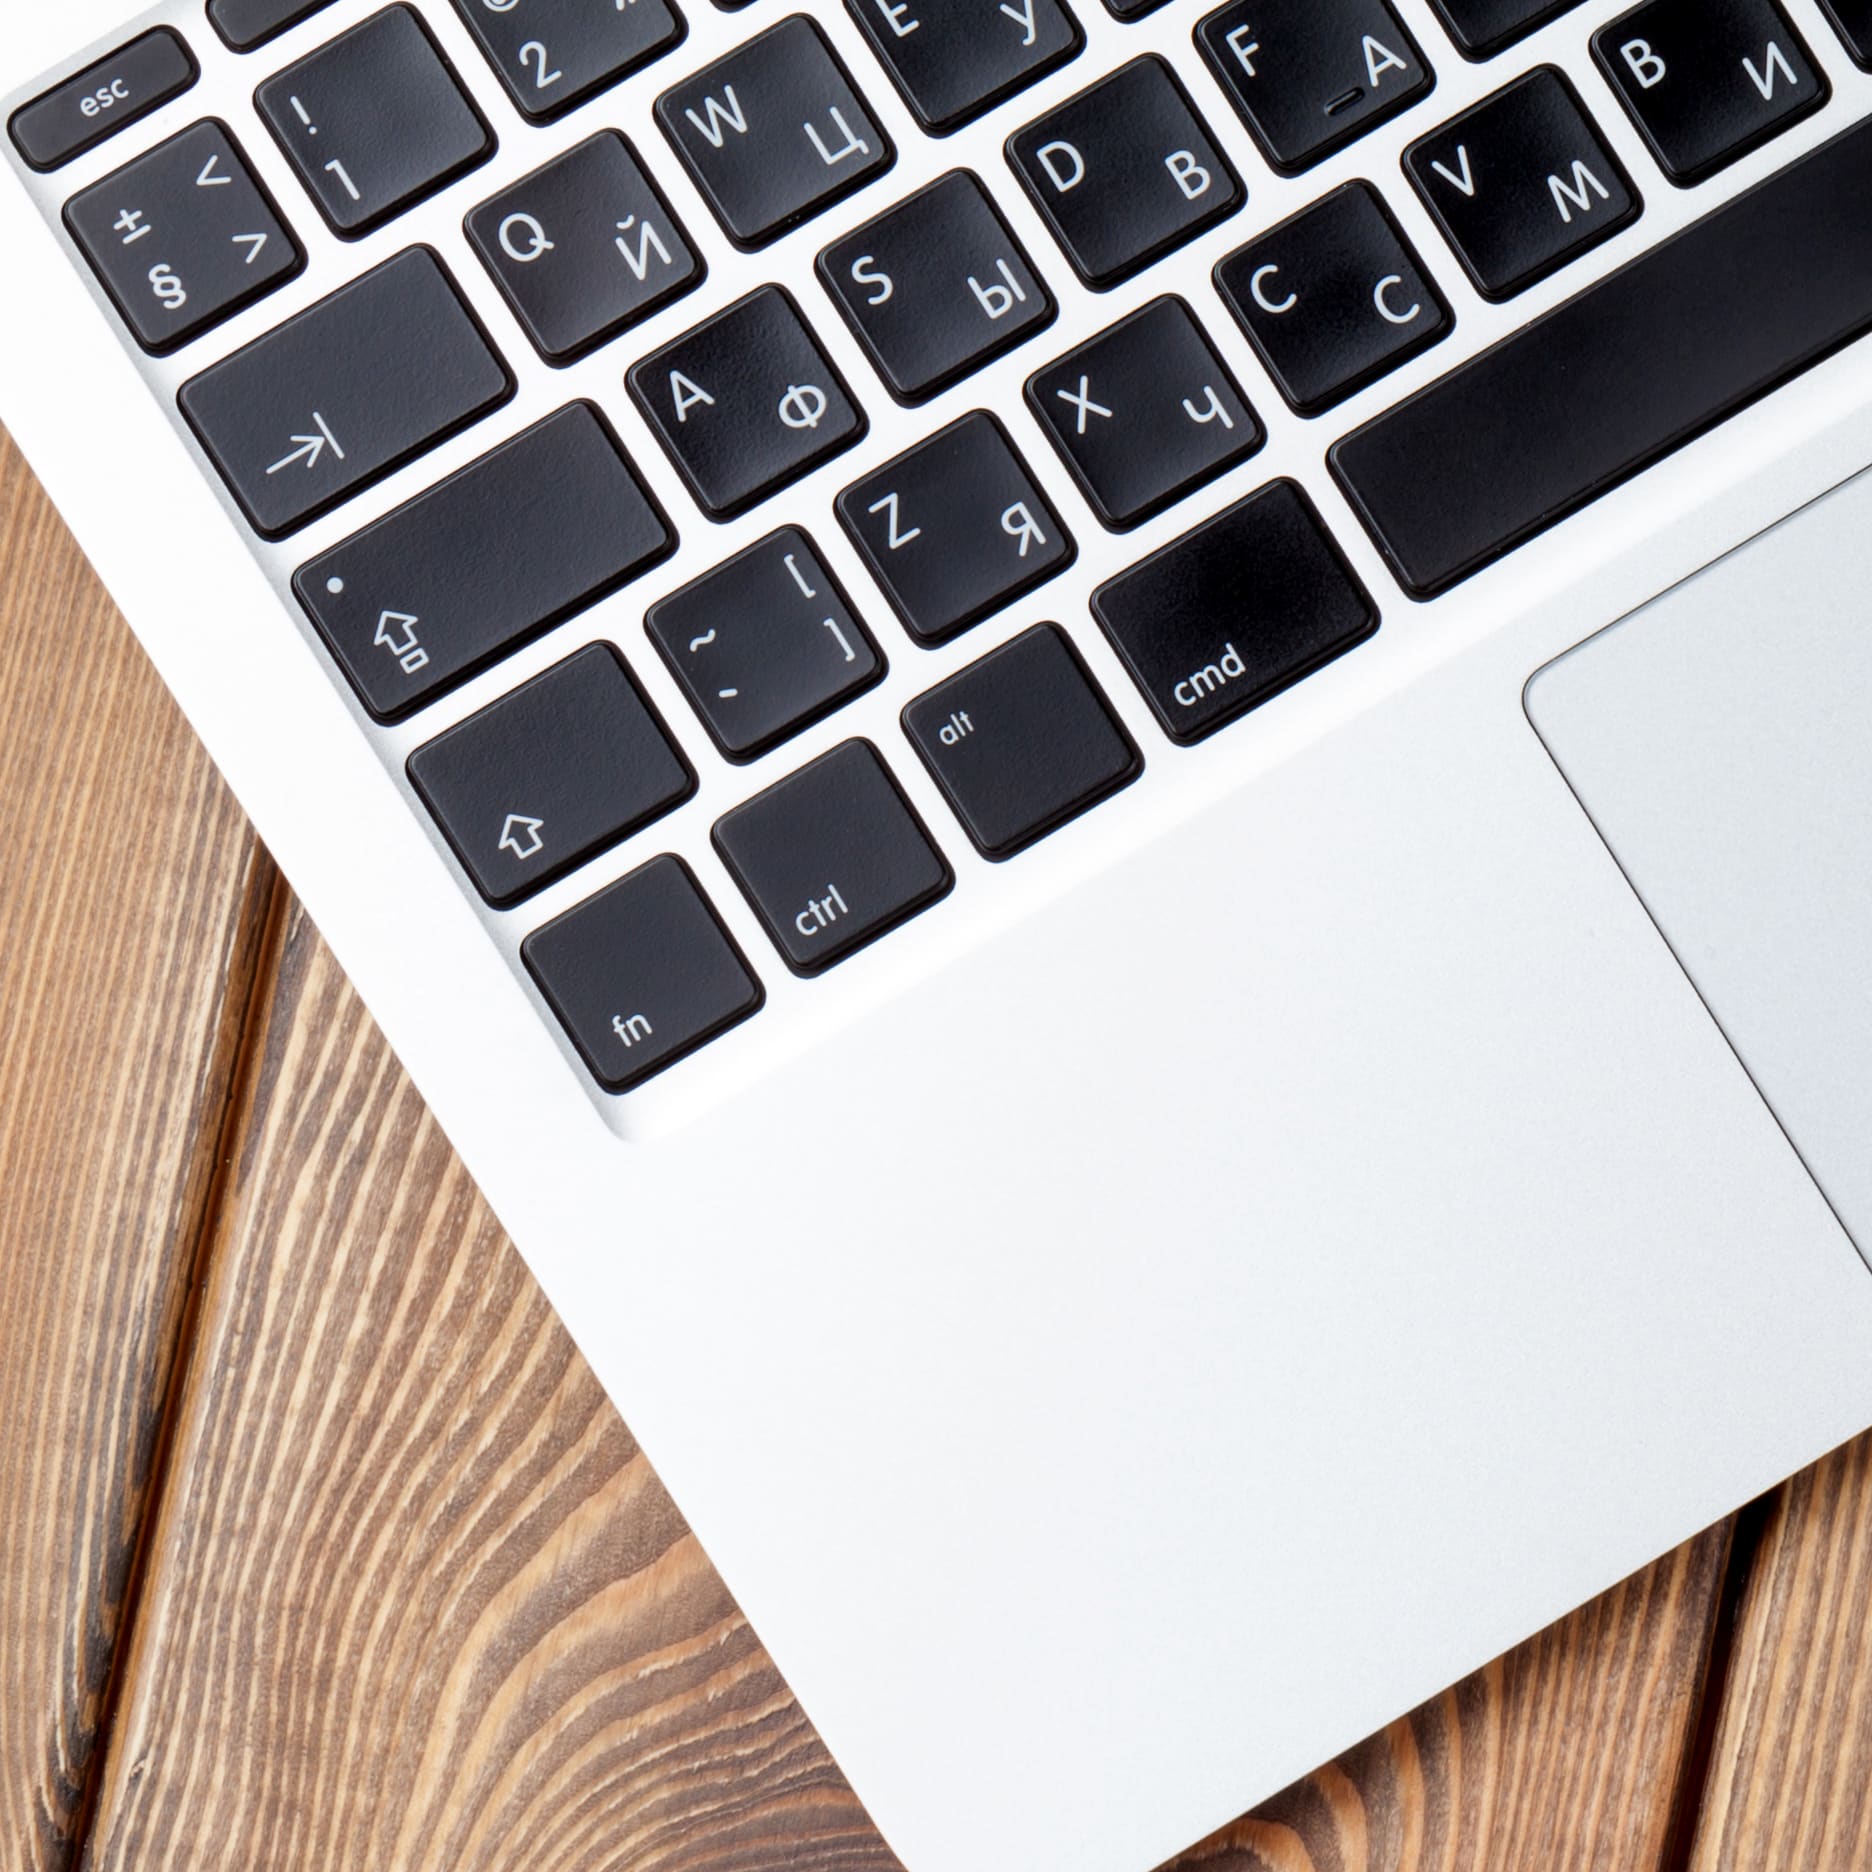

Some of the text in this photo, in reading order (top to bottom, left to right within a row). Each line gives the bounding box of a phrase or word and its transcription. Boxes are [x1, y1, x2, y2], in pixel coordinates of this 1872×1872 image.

[517, 39, 564, 90] 2
[1224, 23, 1260, 78] F
[1361, 34, 1408, 89] А
[1619, 38, 1667, 90] B
[1741, 40, 1799, 102] И
[78, 77, 131, 118] esc
[684, 83, 749, 149] W
[802, 105, 871, 167] Ц
[323, 158, 362, 202] 1
[1035, 140, 1086, 194] D
[1163, 149, 1212, 201] В
[1430, 144, 1476, 197] V
[1546, 159, 1611, 224] М
[497, 211, 556, 263] Q
[613, 213, 674, 282] Й
[850, 254, 894, 306] S
[966, 257, 1028, 321] Ы
[1249, 263, 1298, 314] C
[668, 369, 716, 423] A
[777, 383, 828, 430] Ф
[1056, 374, 1114, 435] X
[1181, 384, 1235, 430] Ч
[867, 491, 922, 551] Z
[999, 500, 1048, 558] Я
[1173, 641, 1247, 707] cmd
[938, 708, 976, 747] alt
[794, 883, 850, 939] ctrl
[610, 1008, 654, 1049] fn
